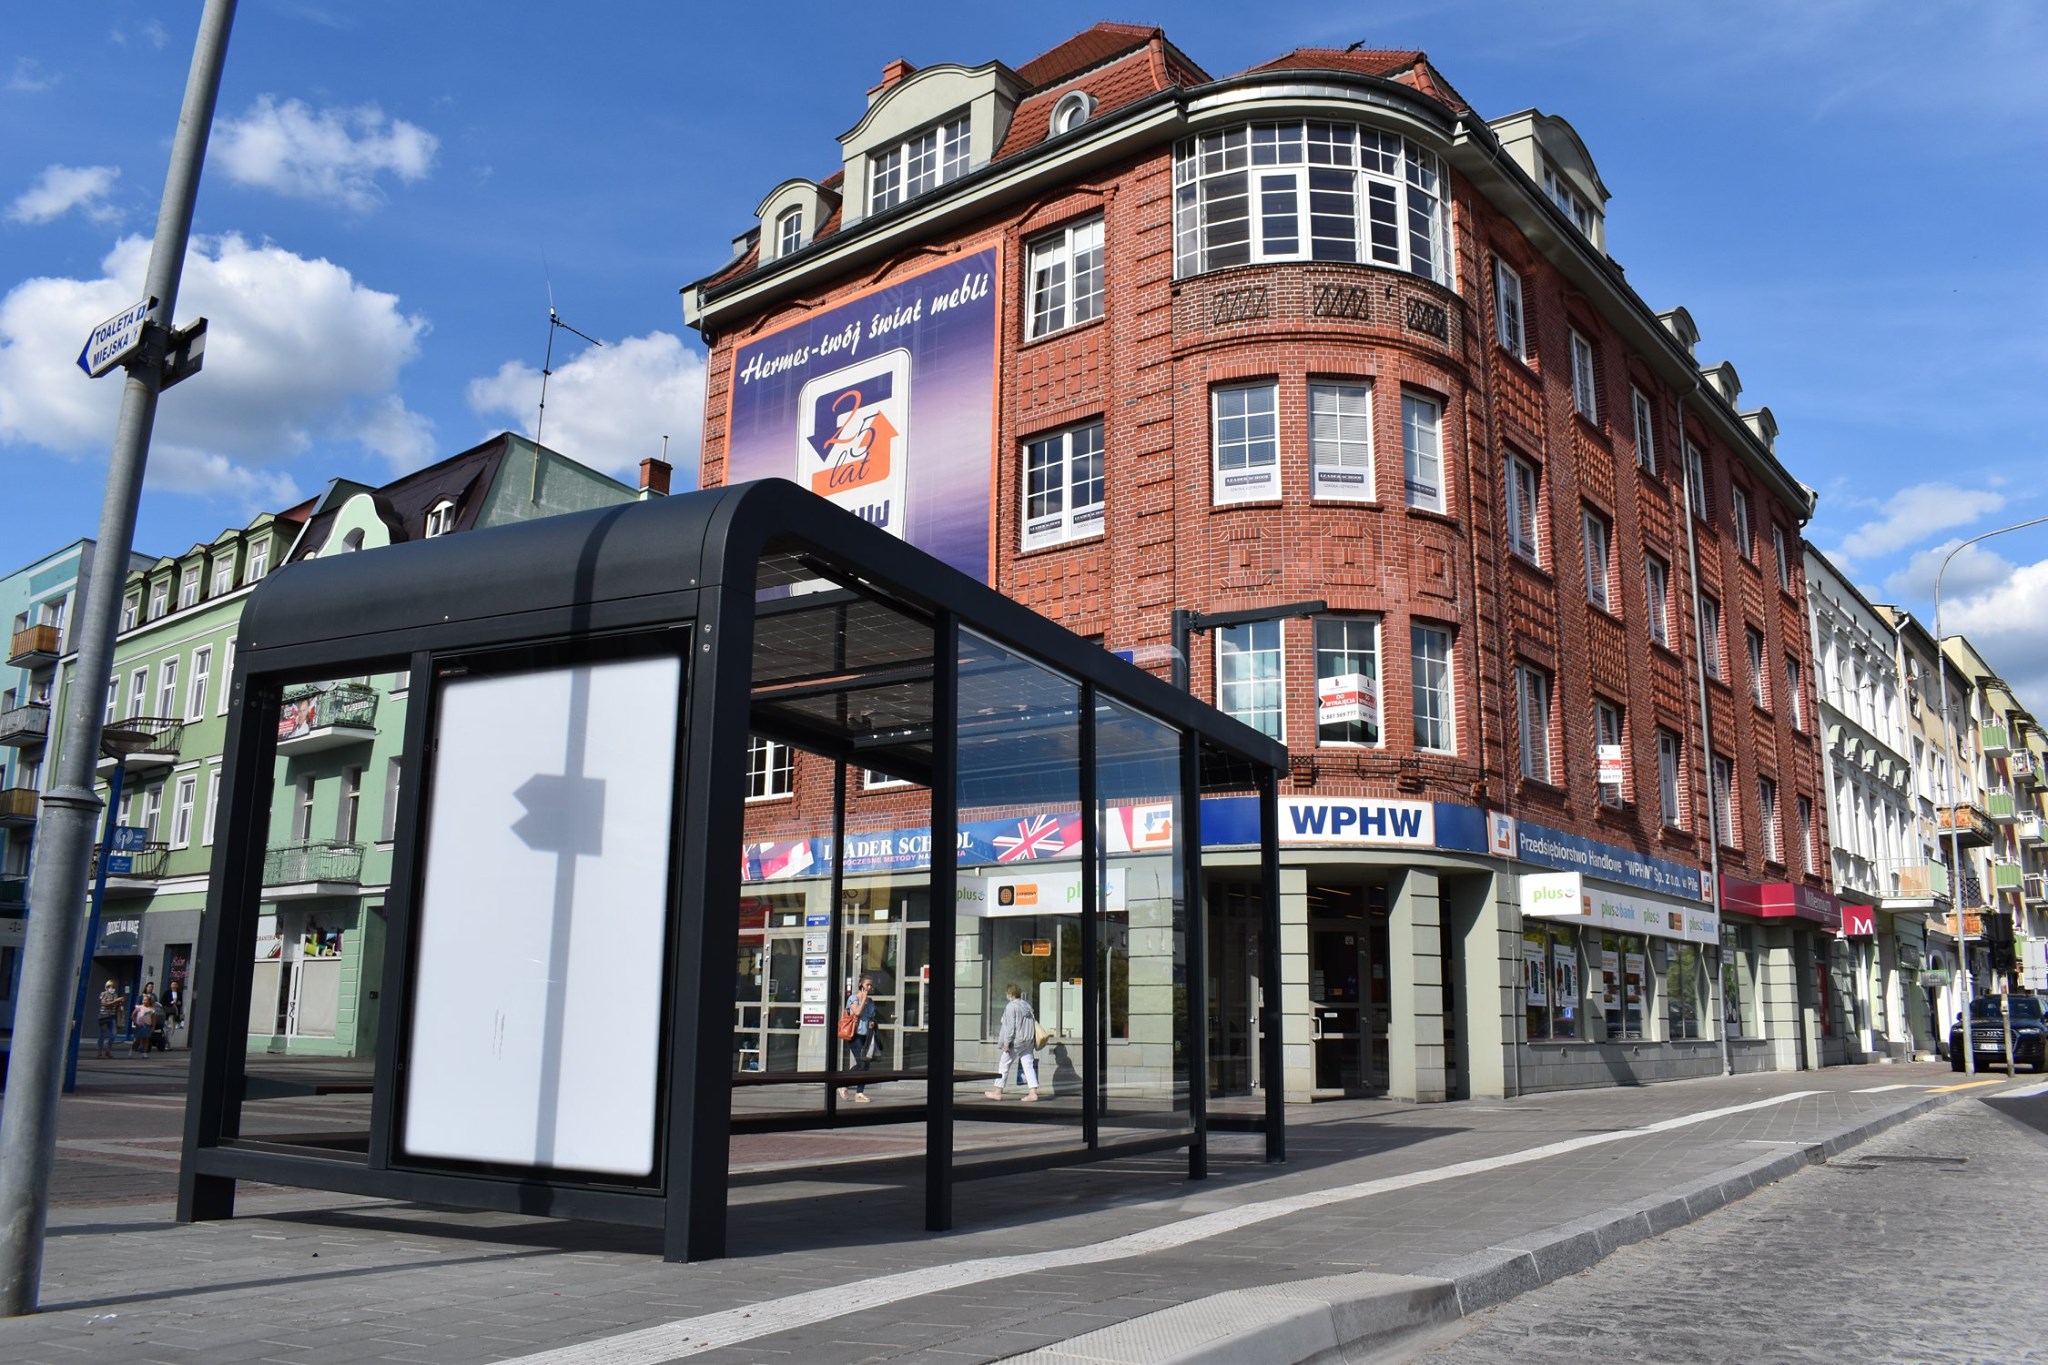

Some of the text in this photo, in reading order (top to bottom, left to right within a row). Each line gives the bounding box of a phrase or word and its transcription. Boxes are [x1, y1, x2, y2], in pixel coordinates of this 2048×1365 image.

[869, 300, 921, 339] świat
[930, 273, 989, 316] mebli
[95, 311, 134, 346] TOALETA
[93, 333, 129, 368] MIEJSKA
[829, 450, 871, 489] lat
[1325, 698, 1356, 707] WYNAJĘCIA
[1289, 805, 1422, 838] WPHW
[823, 839, 893, 860] LADER
[898, 831, 974, 855] SCHL
[883, 854, 917, 863] METODY
[1519, 832, 1587, 864] Przedsiębiorstwo
[1588, 850, 1622, 873] Handlowe
[1653, 867, 1665, 886] Sp.
[1687, 876, 1698, 892] Pile
[957, 887, 977, 902] plus
[1533, 886, 1564, 903] plus
[1601, 900, 1635, 920] plus bank
[1643, 907, 1656, 925] plus
